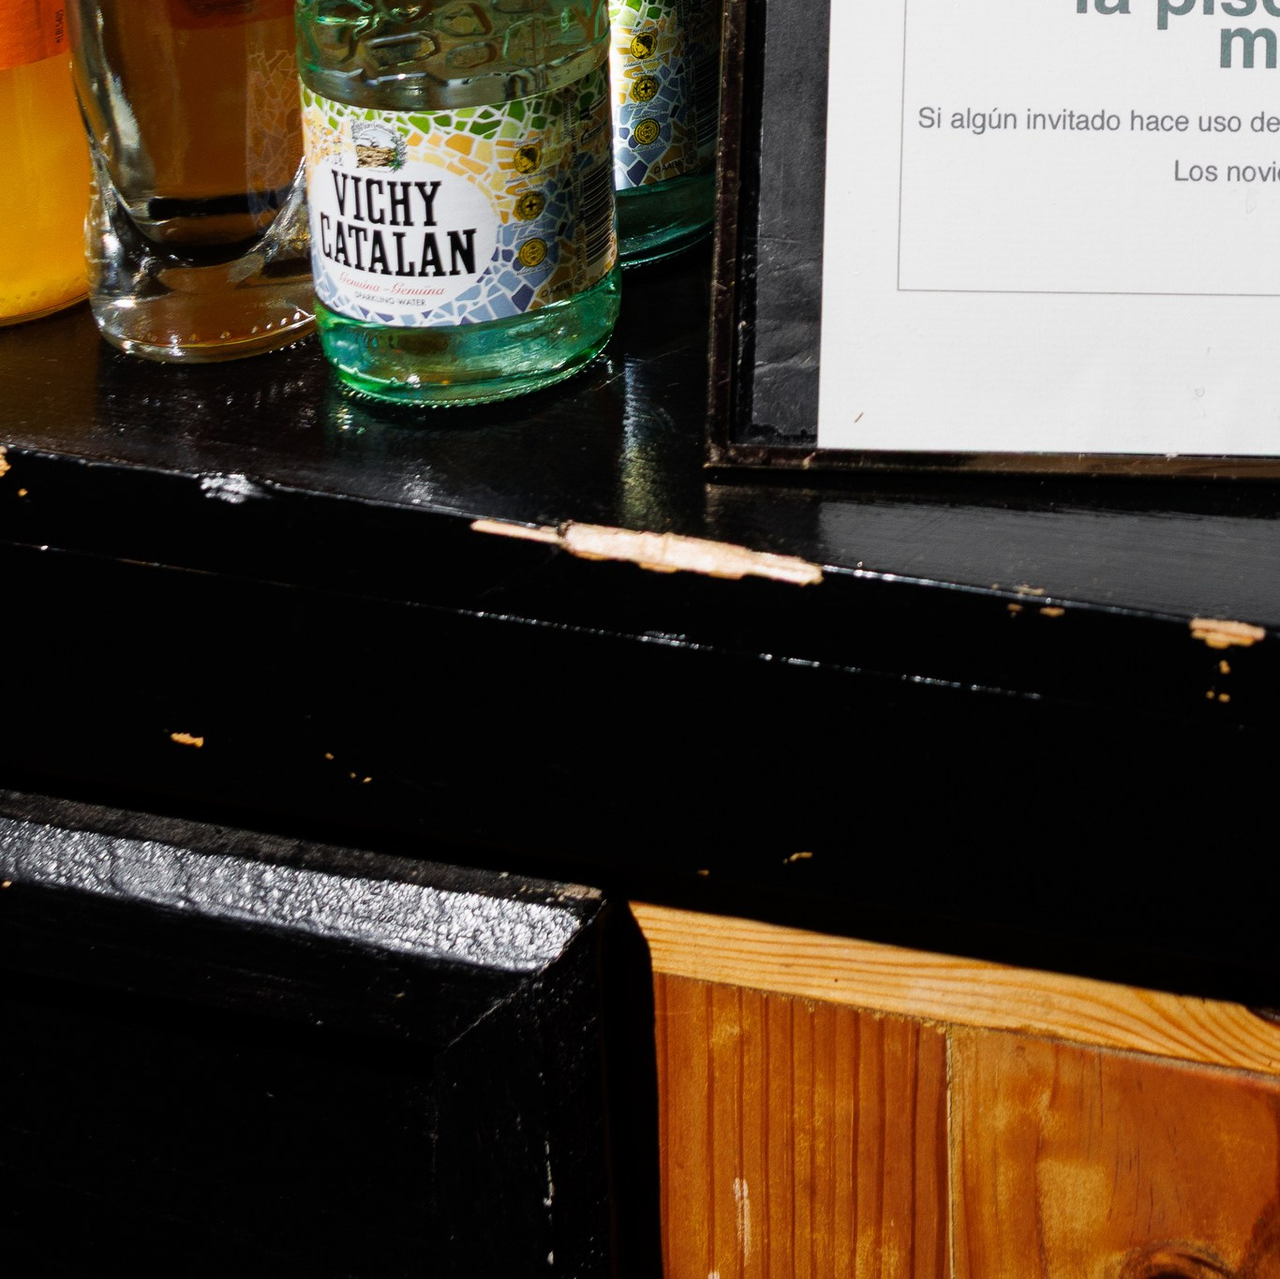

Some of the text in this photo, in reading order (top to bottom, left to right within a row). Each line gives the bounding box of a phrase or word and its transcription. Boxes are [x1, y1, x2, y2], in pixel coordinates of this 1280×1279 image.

[919, 107, 941, 128] Si
[951, 108, 1017, 135] algún
[1027, 108, 1120, 131] invitado
[1131, 110, 1189, 132] hace
[1199, 116, 1241, 132] uso
[1251, 111, 1280, 133] de
[1175, 160, 1218, 182] Los
[331, 169, 442, 227] VICHY
[319, 212, 477, 277] CATALAN
[396, 297, 427, 307] WATER
